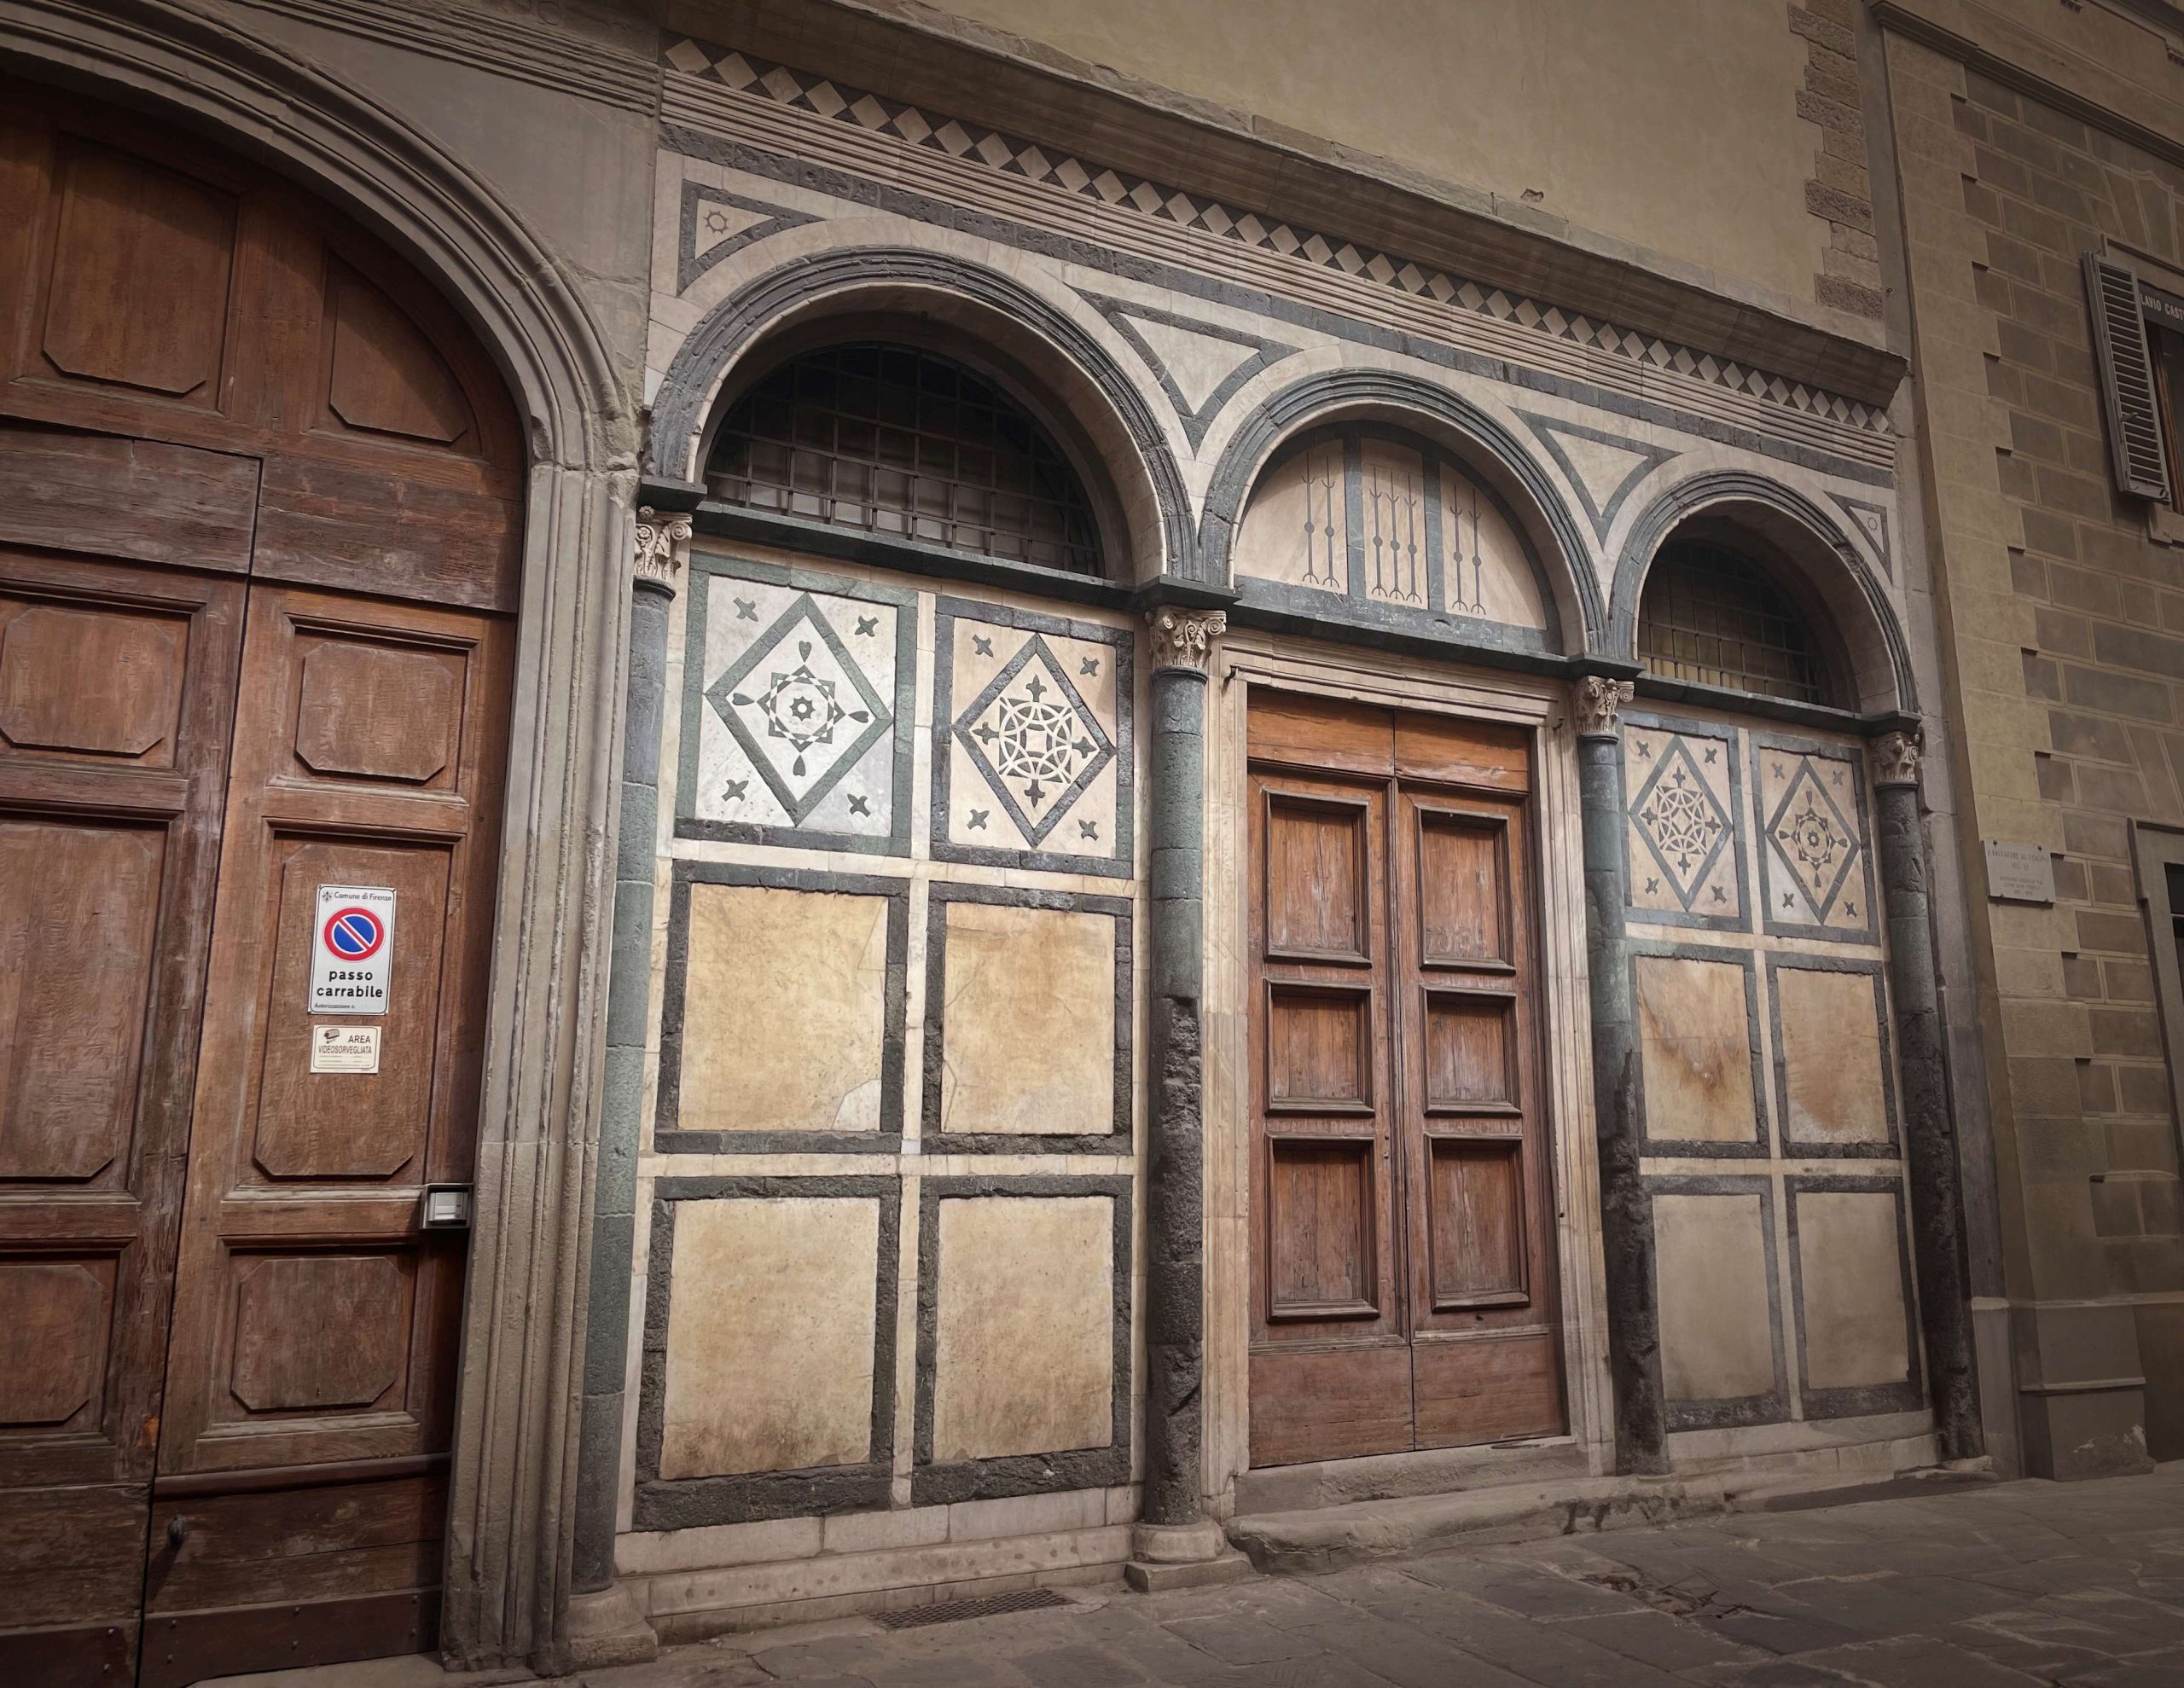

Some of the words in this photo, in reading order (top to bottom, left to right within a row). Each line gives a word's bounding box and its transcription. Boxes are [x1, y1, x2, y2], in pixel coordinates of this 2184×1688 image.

[2140, 293, 2162, 312] LAVIO
[334, 891, 360, 900] Comune
[369, 893, 392, 902] Firenze
[328, 970, 373, 982] passo
[317, 985, 383, 998] carrabile
[347, 1035, 371, 1043] AREA
[318, 1045, 372, 1054] VIDEOSORVEGLIATA
